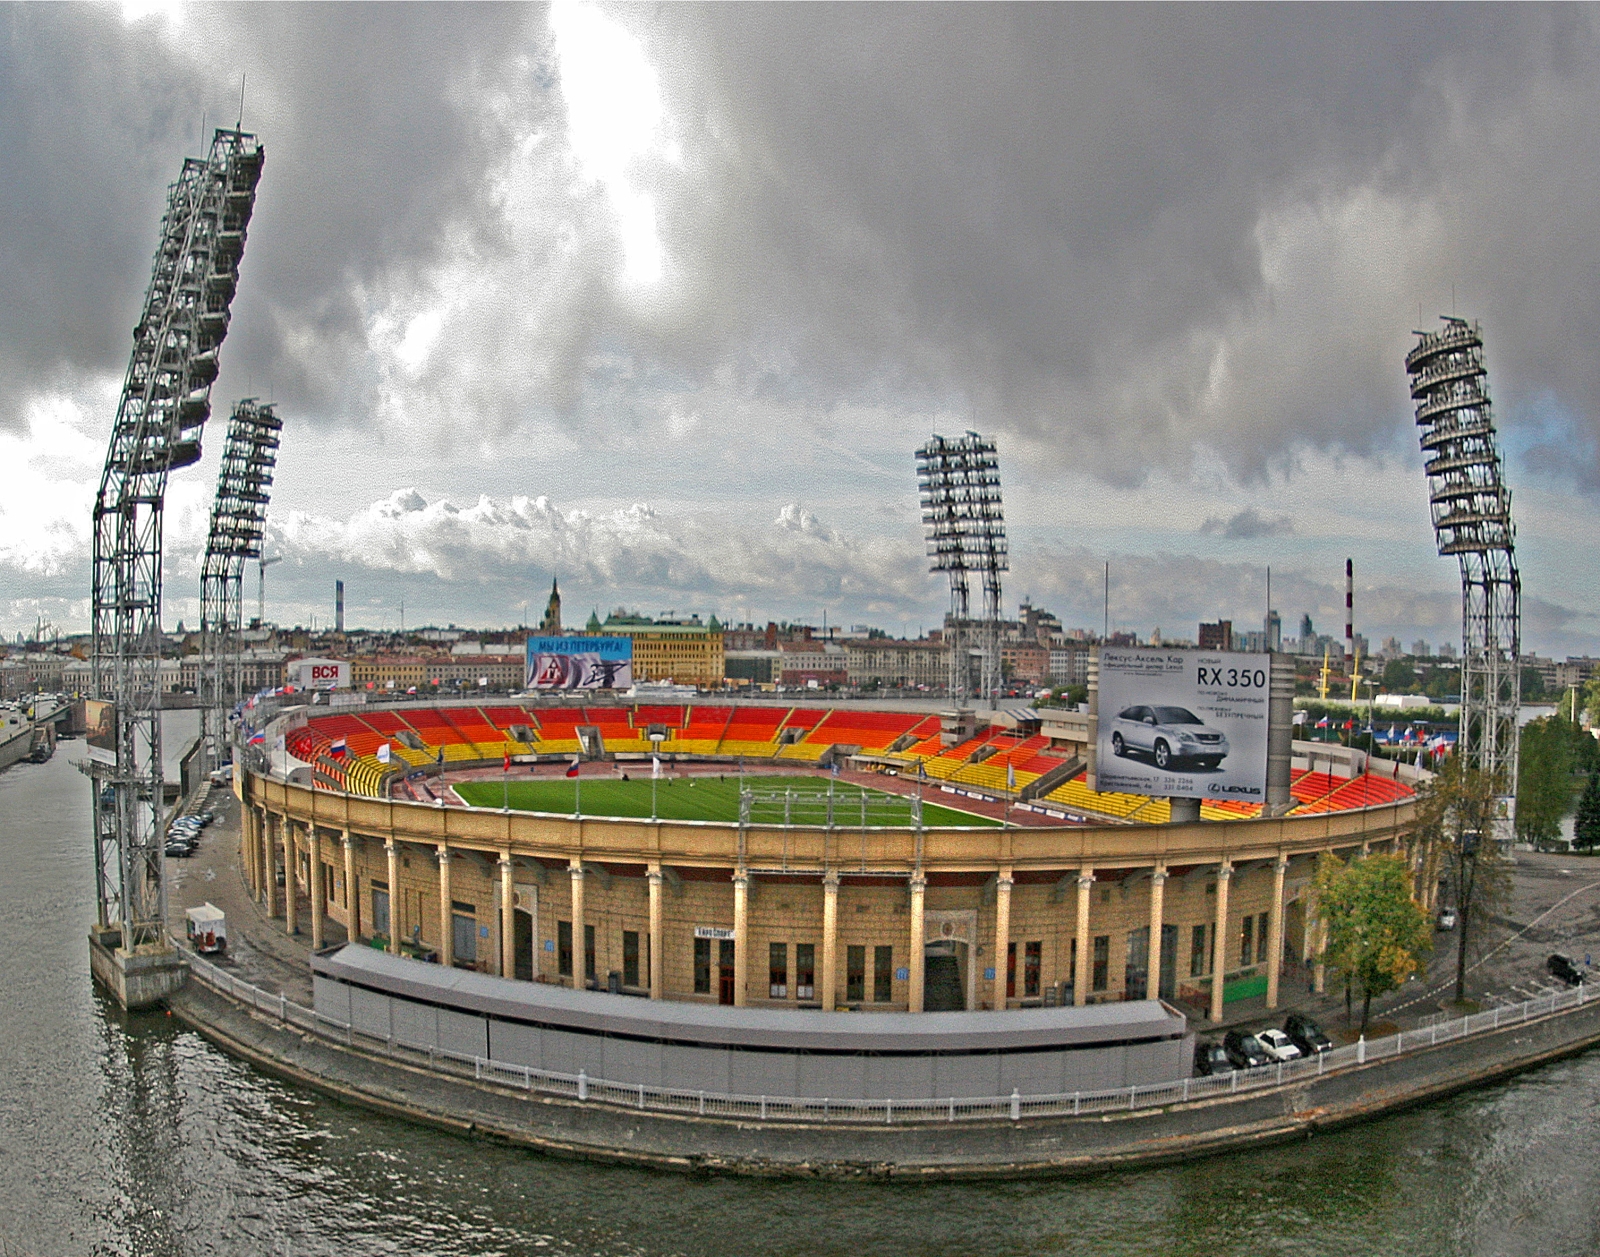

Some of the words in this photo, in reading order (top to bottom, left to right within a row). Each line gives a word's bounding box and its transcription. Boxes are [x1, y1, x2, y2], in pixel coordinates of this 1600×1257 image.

[538, 640, 554, 651] МЫ
[556, 640, 569, 652] ИЗ
[569, 640, 623, 652] ПЕТЕРБУРГА!
[1167, 654, 1184, 664] Кар
[312, 665, 339, 679] ВСЯ
[1197, 667, 1222, 686] RX
[1226, 668, 1266, 688] 350
[1221, 785, 1261, 795] LEXUS
